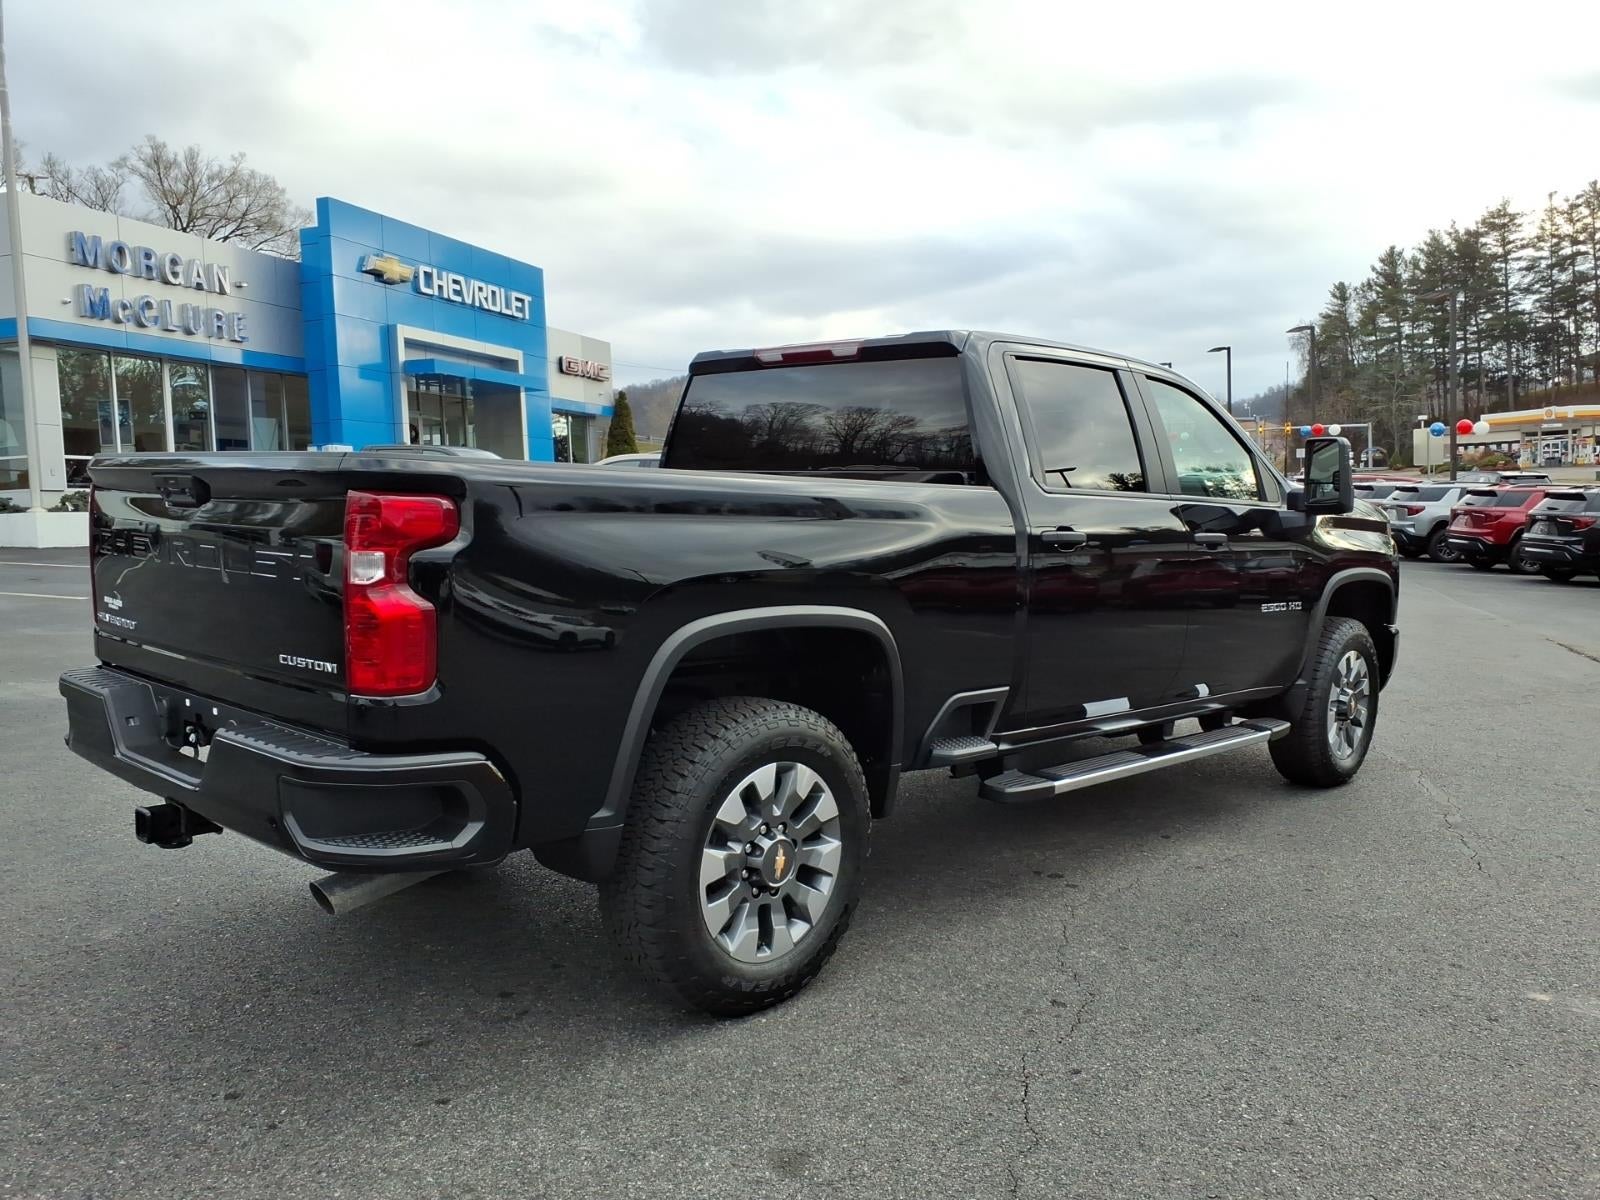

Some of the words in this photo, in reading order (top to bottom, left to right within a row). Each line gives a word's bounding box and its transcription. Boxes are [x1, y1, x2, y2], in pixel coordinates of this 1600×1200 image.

[69, 231, 231, 295] MORGAN
[77, 284, 249, 343] McCLURE
[418, 265, 532, 320] CHEVROLET
[560, 355, 610, 382] GMC
[279, 654, 338, 674] CUSTOM
